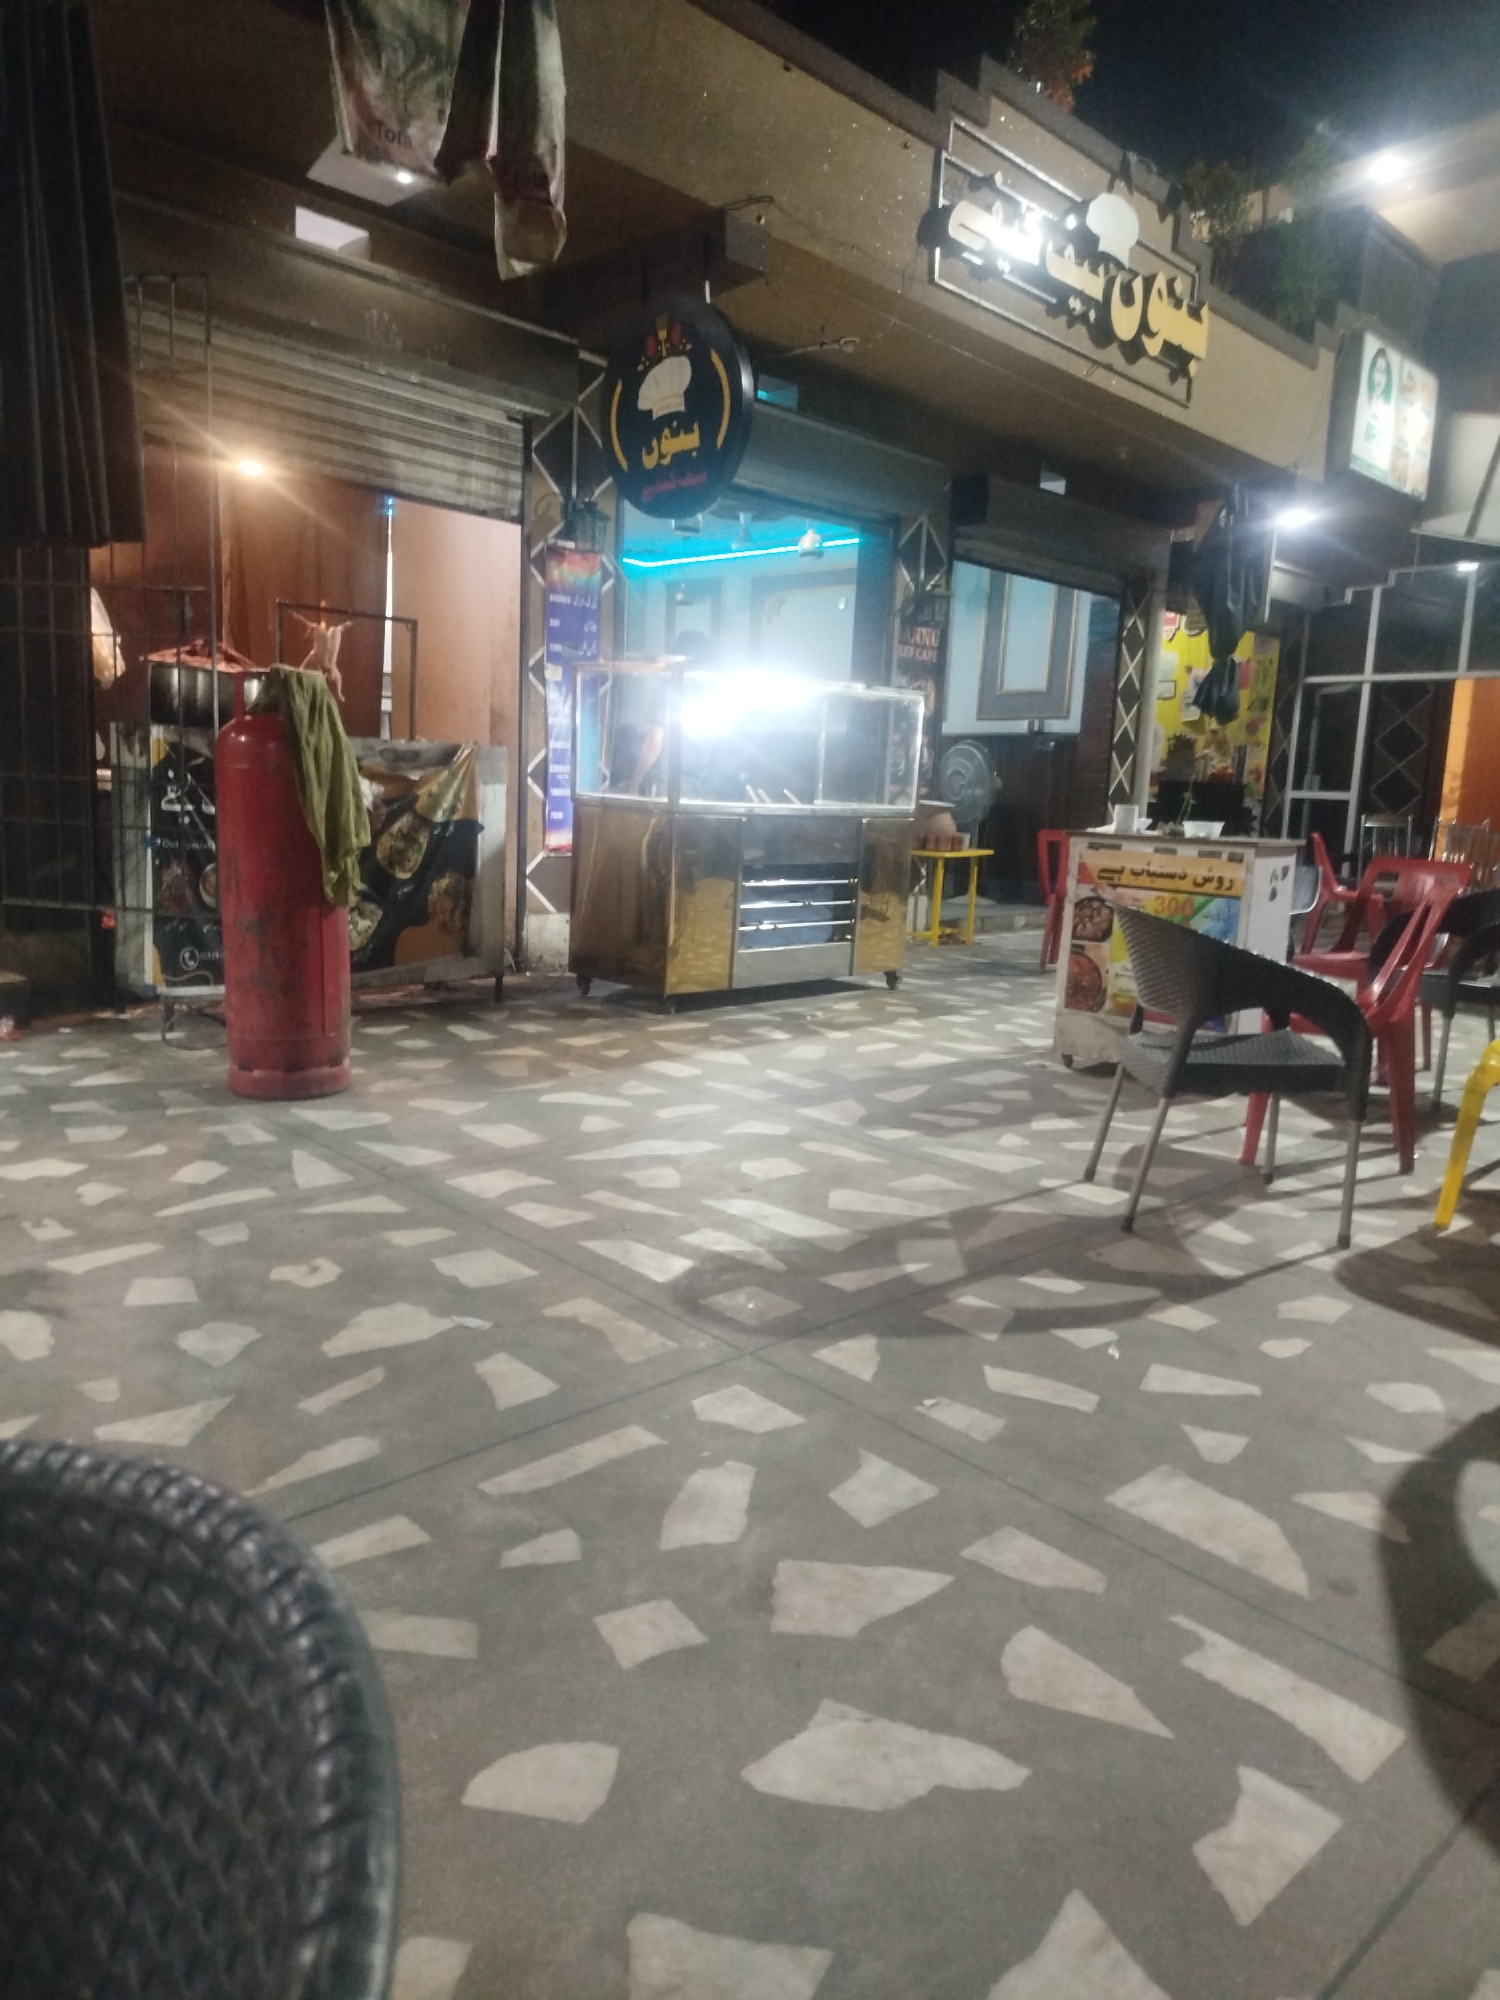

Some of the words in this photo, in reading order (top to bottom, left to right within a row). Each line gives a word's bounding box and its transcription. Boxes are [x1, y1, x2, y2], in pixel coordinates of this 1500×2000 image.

[1109, 270, 1210, 378] بنوں
[641, 420, 700, 470] بنوں
[1097, 863, 1125, 883] ہے
[1153, 895, 1195, 918] 300
